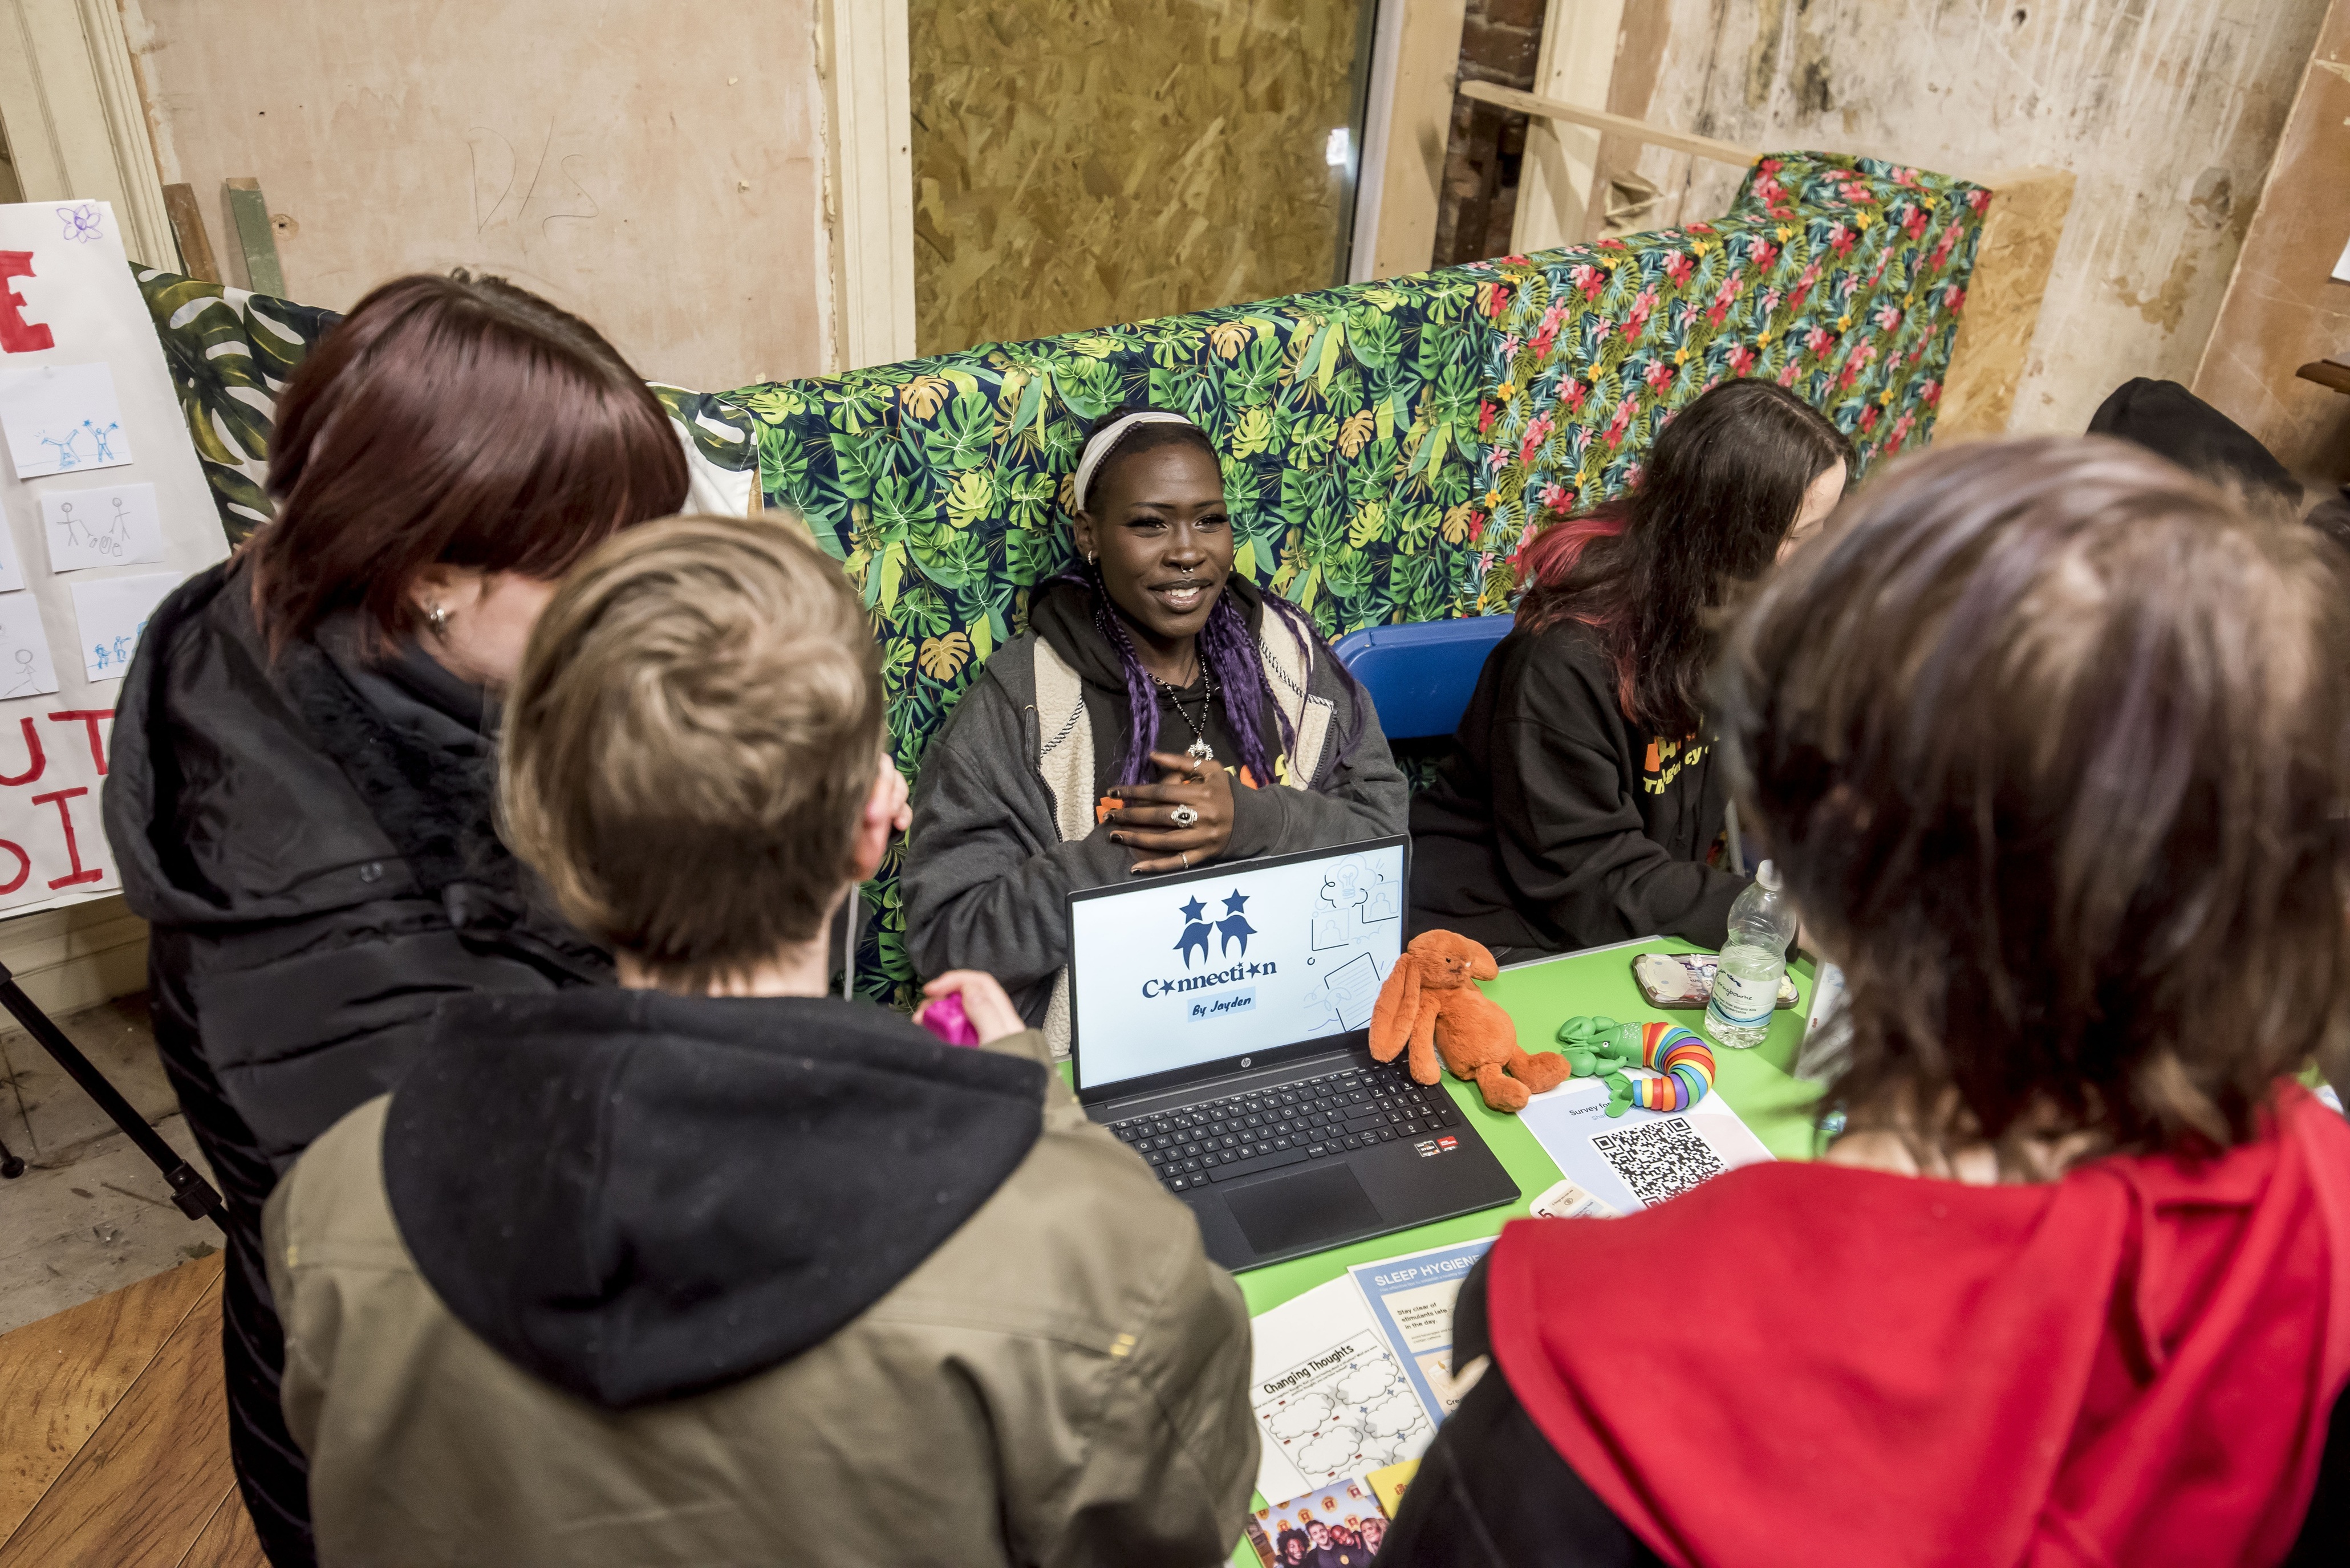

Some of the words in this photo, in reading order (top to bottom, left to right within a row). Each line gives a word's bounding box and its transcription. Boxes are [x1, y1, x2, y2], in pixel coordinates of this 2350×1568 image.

[1192, 1004, 1207, 1017] By
[1210, 996, 1251, 1012] Jayden
[1241, 1058, 1251, 1068] hp
[1569, 1104, 1598, 1116] Survey
[1374, 1268, 1418, 1287] SLEEP
[1401, 1311, 1434, 1322] stimulants
[1264, 1367, 1311, 1394] Changing
[1307, 1345, 1354, 1372] Thoughts
